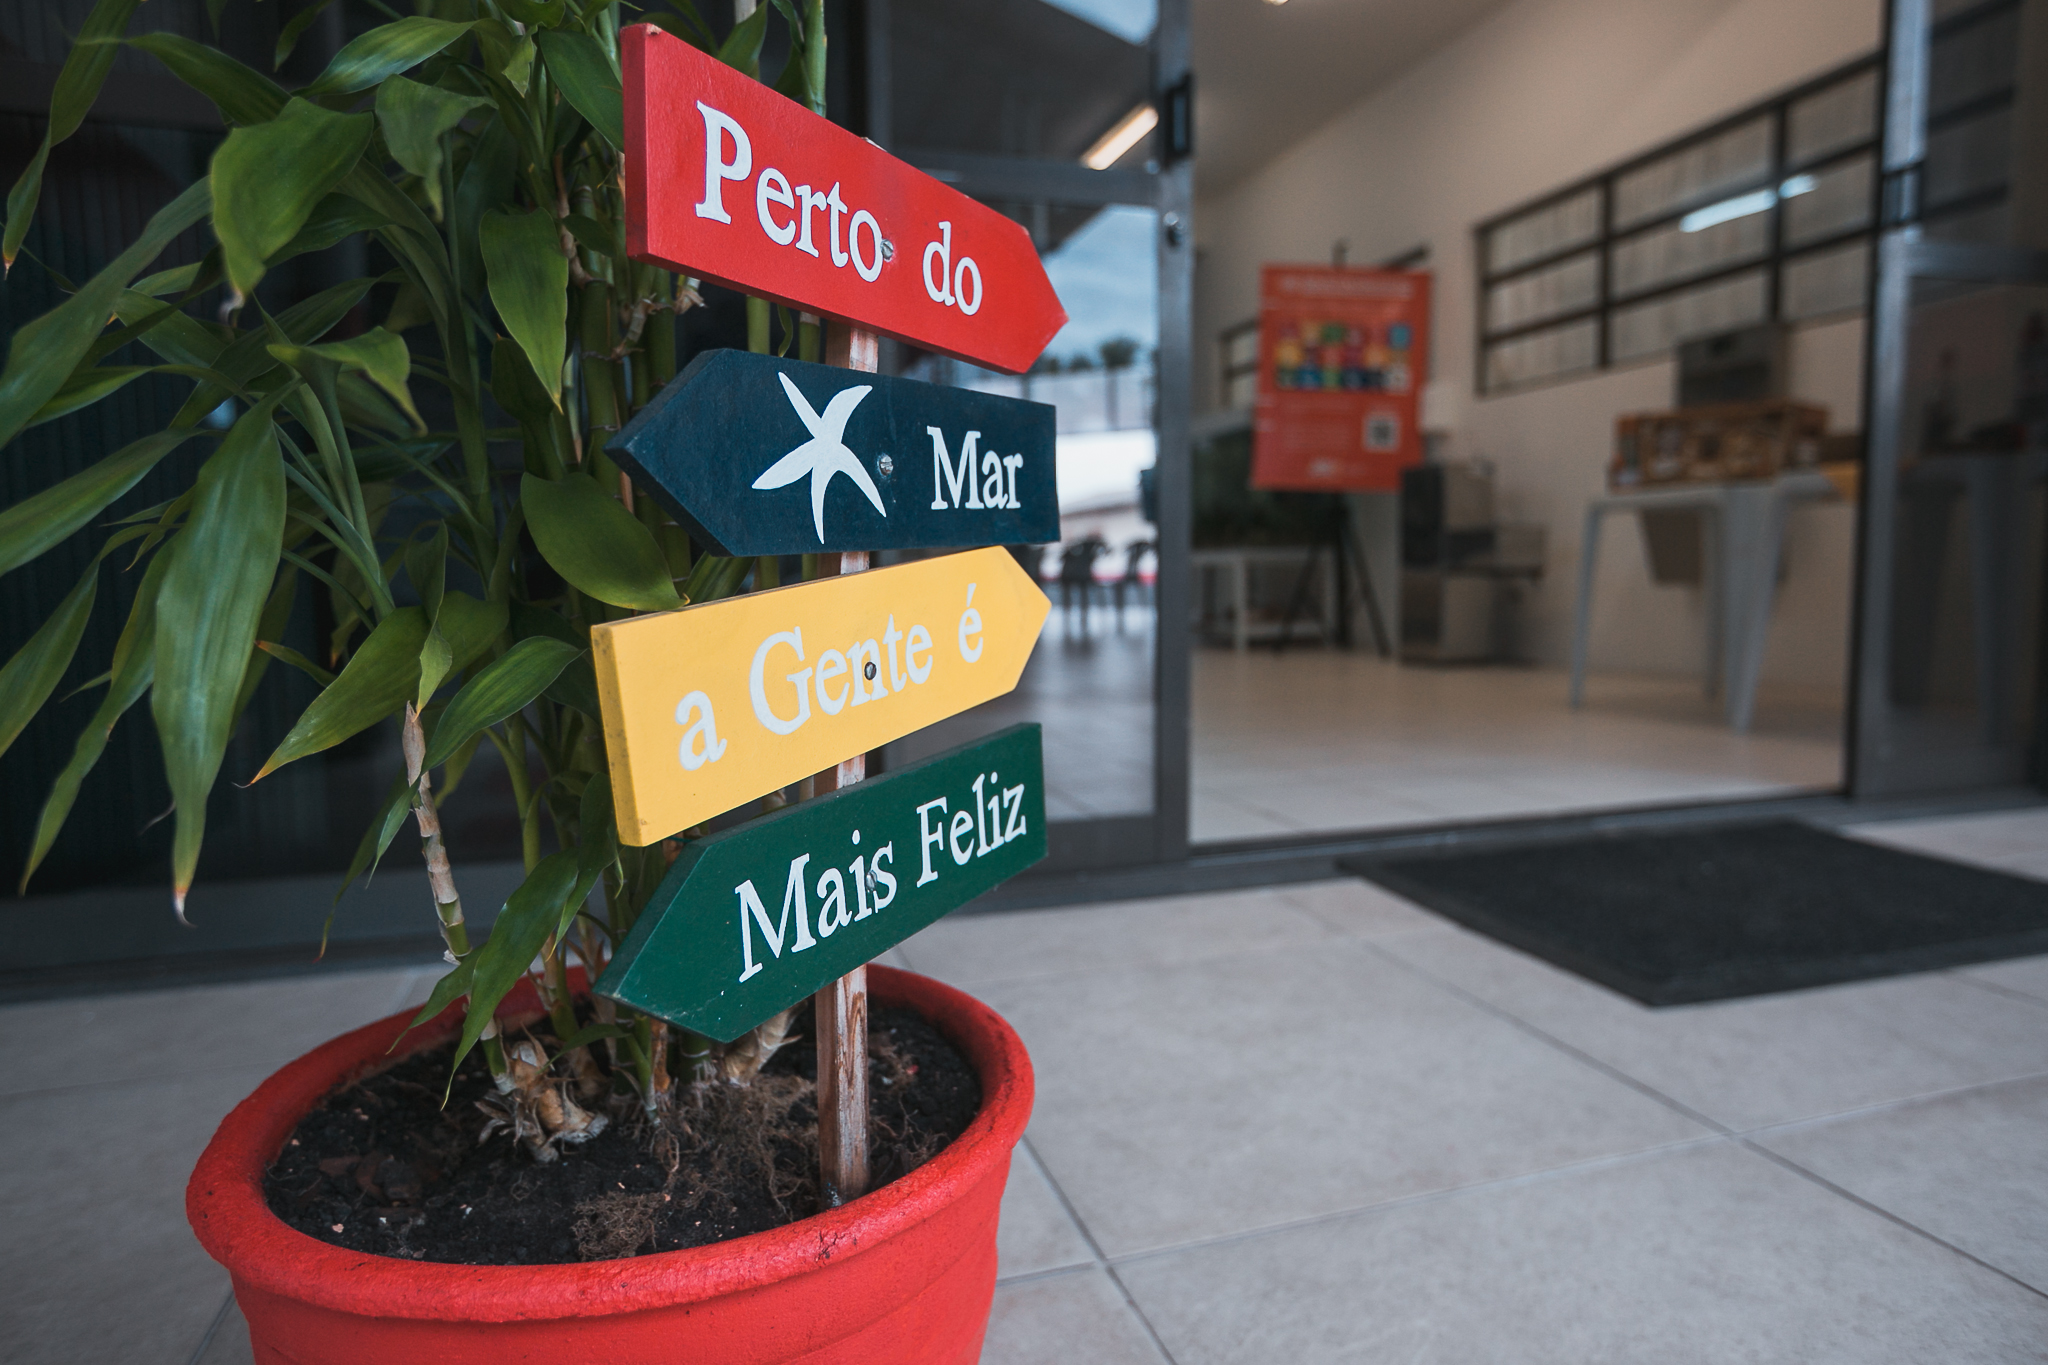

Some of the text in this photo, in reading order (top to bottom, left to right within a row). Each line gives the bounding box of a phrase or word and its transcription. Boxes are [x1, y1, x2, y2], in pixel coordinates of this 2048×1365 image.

[695, 100, 983, 316] Perto do
[926, 425, 1024, 510] Mar
[675, 583, 984, 771] a Gente é
[734, 771, 1027, 983] Mais Feliz
